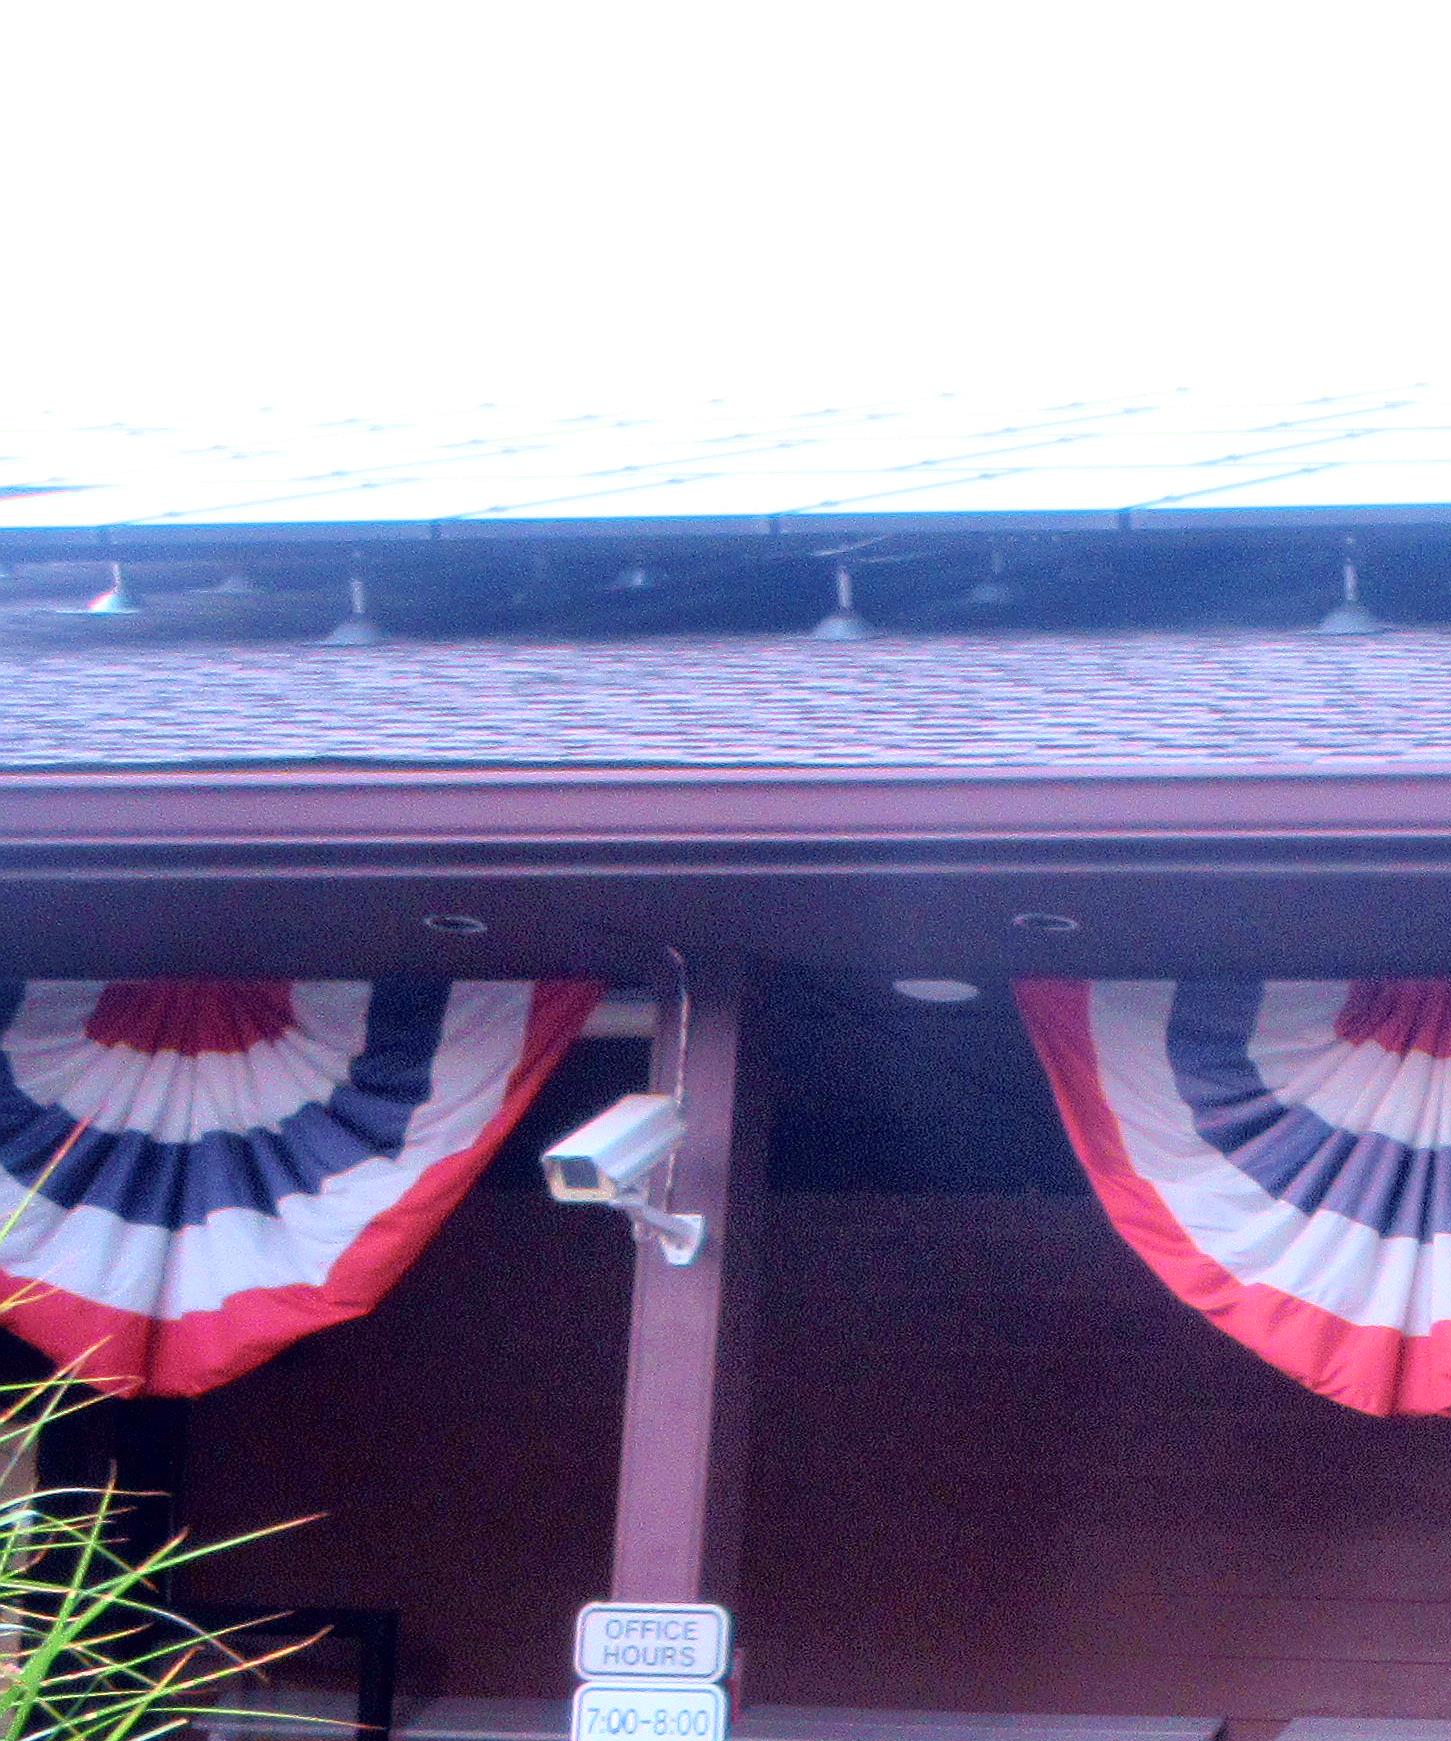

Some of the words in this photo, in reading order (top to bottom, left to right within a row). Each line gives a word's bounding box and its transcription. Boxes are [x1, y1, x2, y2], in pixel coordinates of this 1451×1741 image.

[605, 1618, 699, 1641] OFFICE
[602, 1645, 696, 1667] HOURS
[587, 1707, 709, 1737] 7:00-8:00
